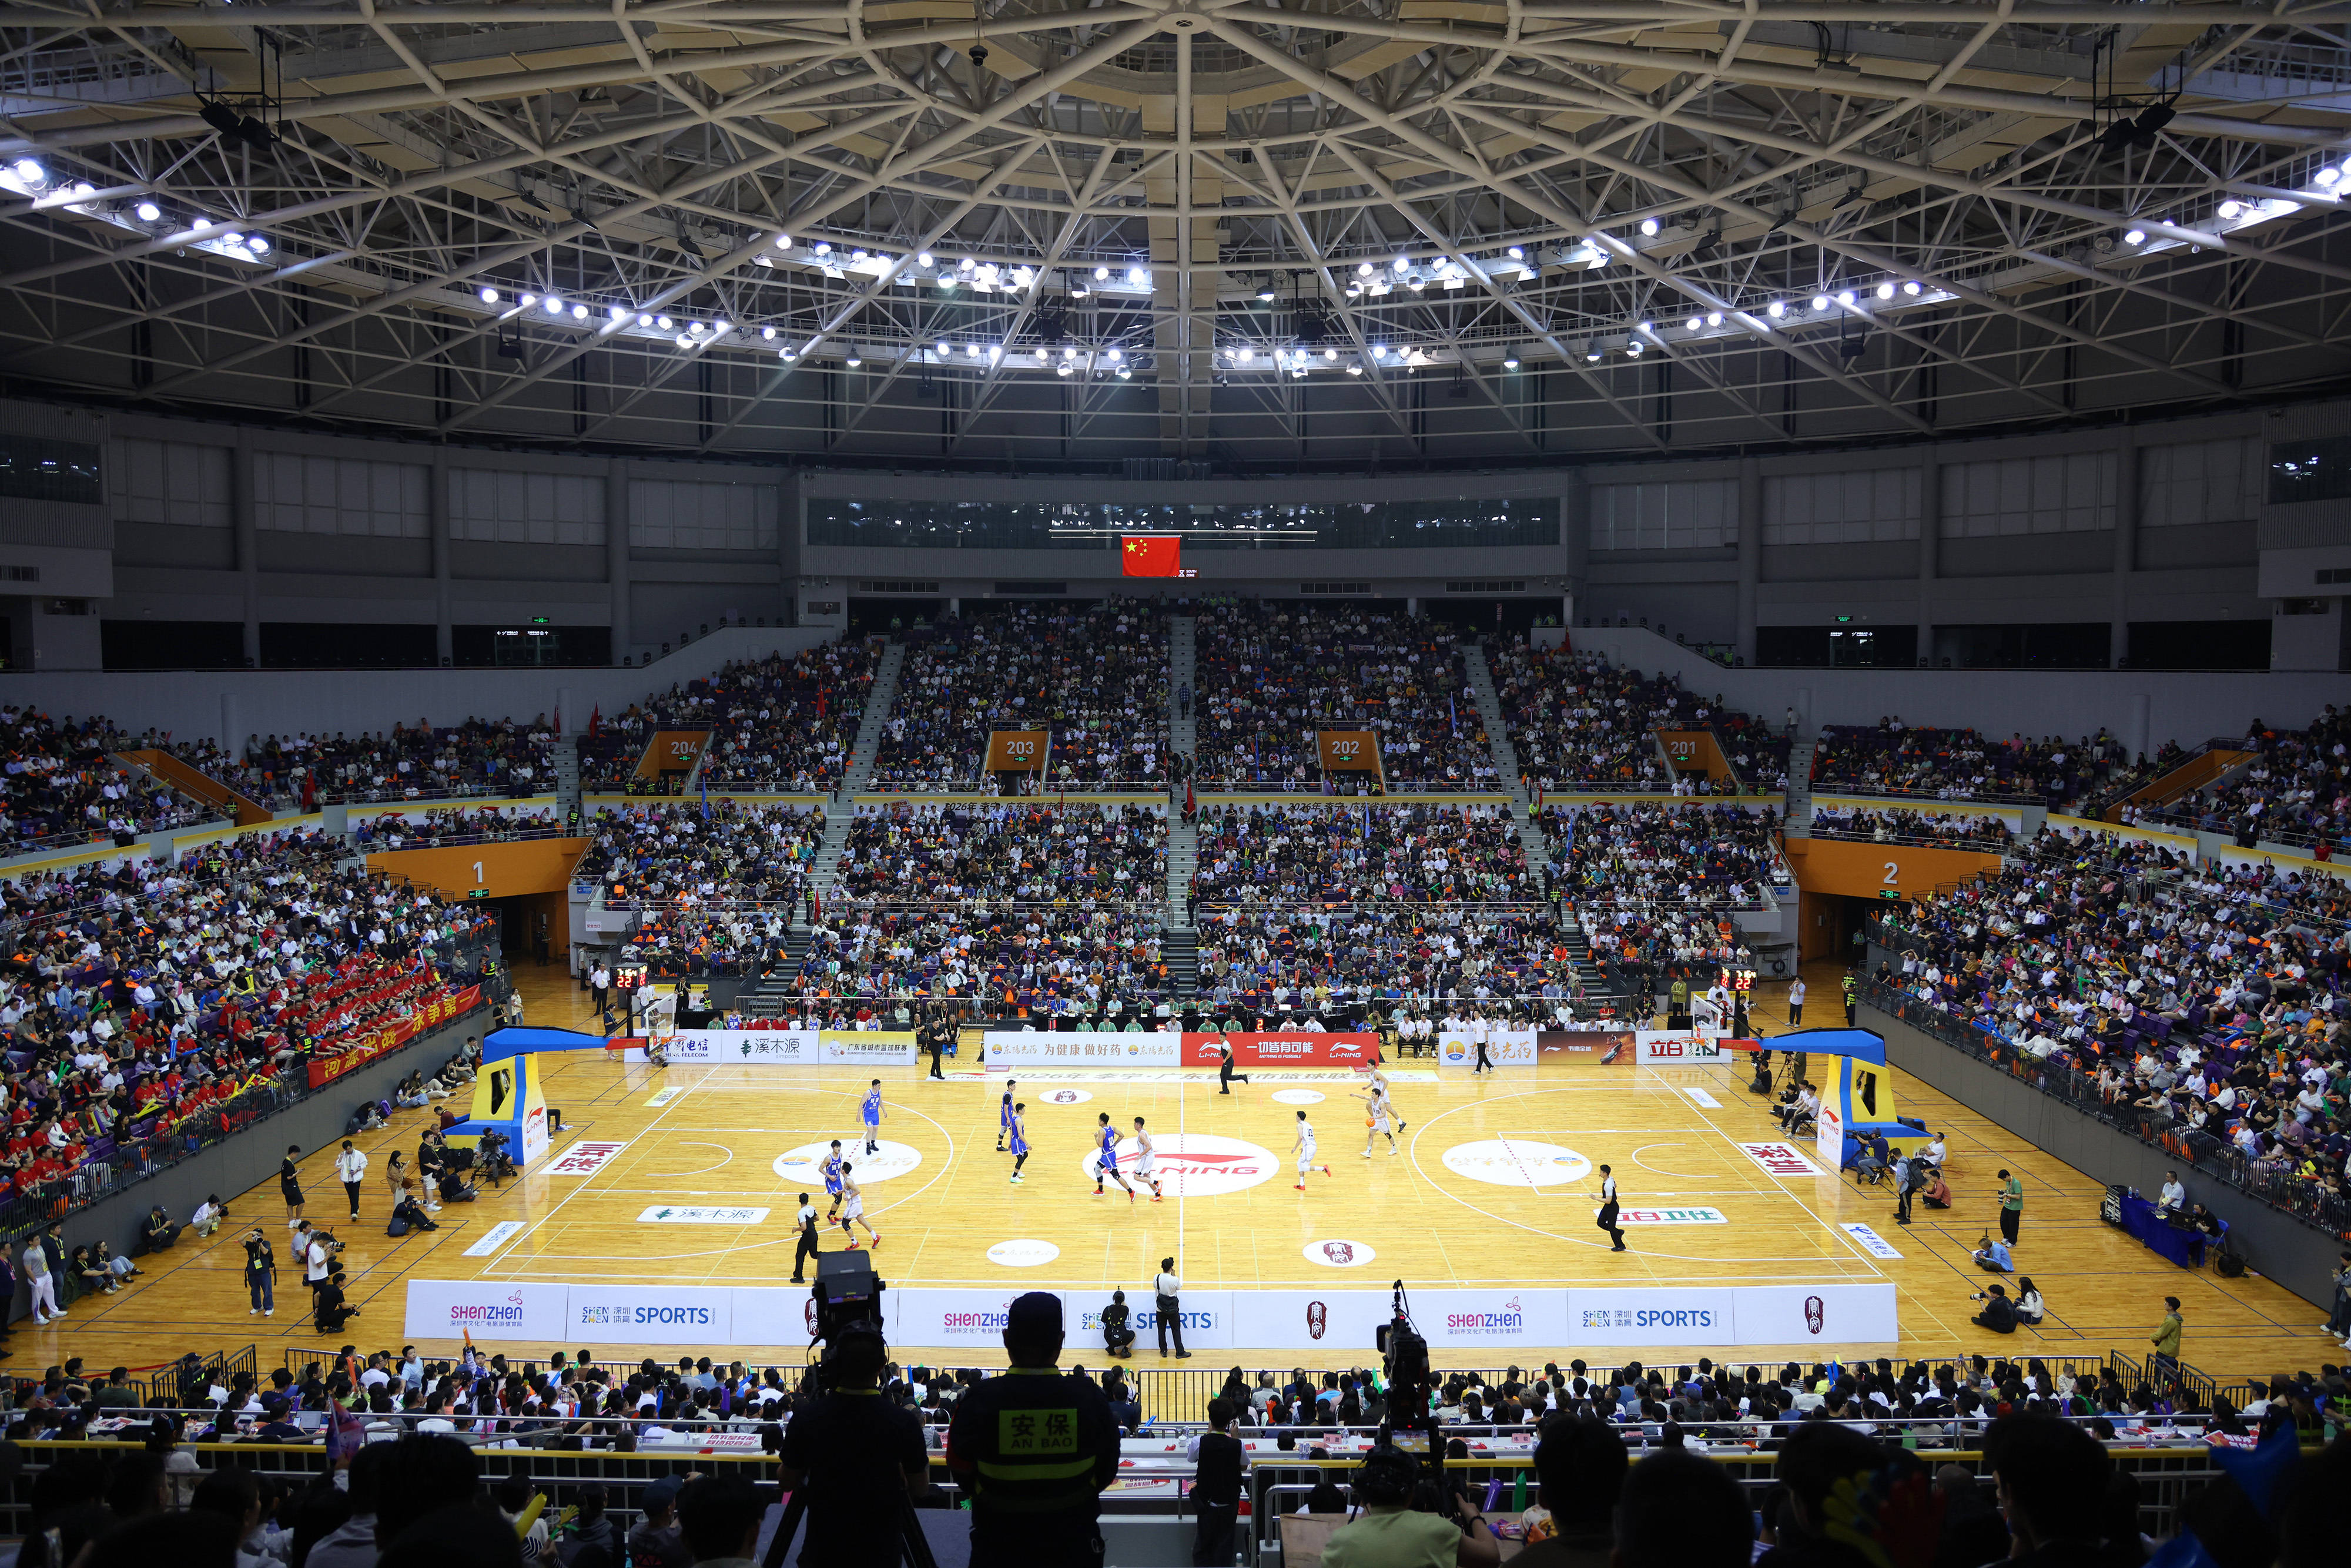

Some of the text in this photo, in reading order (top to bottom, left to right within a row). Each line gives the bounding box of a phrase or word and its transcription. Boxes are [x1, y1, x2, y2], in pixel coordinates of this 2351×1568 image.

[671, 742, 698, 755] 204
[1007, 742, 1034, 754] 203
[1332, 741, 1359, 754] 202
[1670, 742, 1696, 754] 201
[943, 802, 1096, 812] 2026年 李宁·广东省城市球联赛
[1287, 803, 1321, 812] 2026年
[78, 860, 108, 873] SPOTS
[473, 861, 483, 883] 1
[1883, 862, 1898, 884] 2
[617, 977, 632, 987] 22
[1736, 978, 1751, 989] 22
[1257, 1019, 1262, 1030] 2
[324, 994, 471, 1078] 河源出战 永争第一
[755, 1038, 799, 1053] 溪木源
[1044, 1044, 1121, 1056] 为健康 做好药
[1247, 1041, 1314, 1054] 一切皆有可能
[677, 1208, 756, 1219] 溪木源
[635, 1307, 709, 1323] SPORTS
[945, 1314, 1009, 1326] SHenZHe
[1136, 1312, 1211, 1329] SPRTS
[1637, 1310, 1710, 1326] SPORTS
[1011, 1413, 1070, 1437] 安保
[1011, 1438, 1073, 1449] AN BAO
